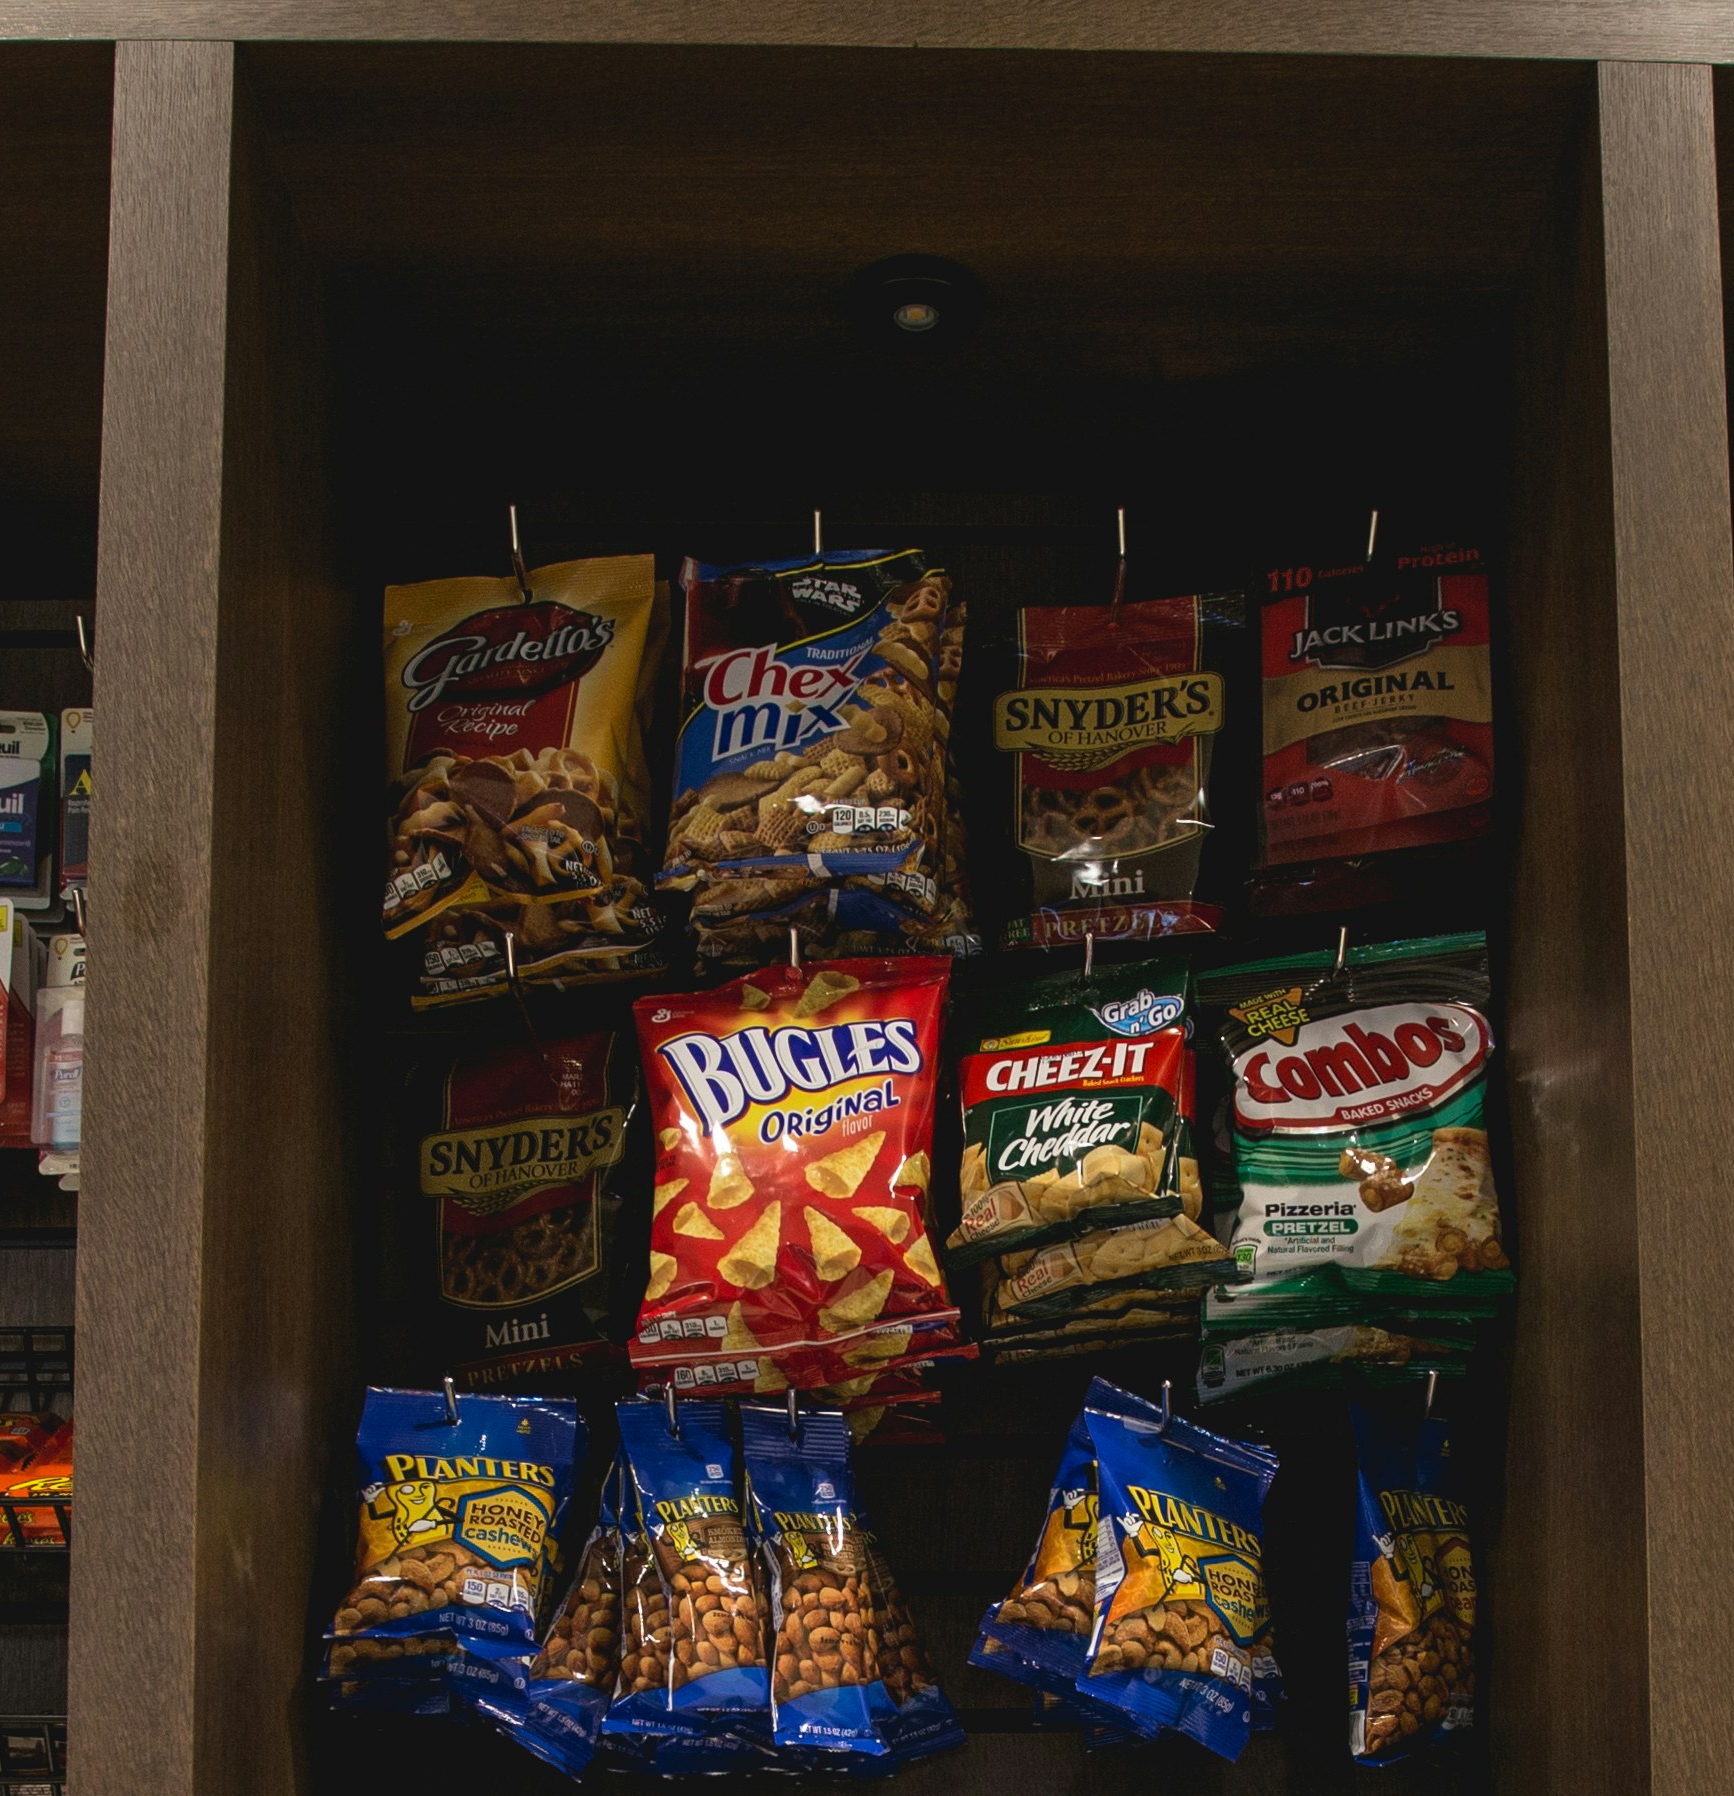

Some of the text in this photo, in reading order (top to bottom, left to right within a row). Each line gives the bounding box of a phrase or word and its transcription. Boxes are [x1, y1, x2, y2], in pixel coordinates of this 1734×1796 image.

[1396, 547, 1480, 571] Protein
[1267, 567, 1313, 591] 110
[806, 637, 875, 661] TRADITIONAL
[1290, 609, 1460, 659] JACK LINK'S
[700, 645, 868, 708] Chex
[1296, 670, 1454, 713] ORIGINAL
[438, 698, 530, 726] Original
[1006, 680, 1213, 732] SNYDER'S
[445, 717, 519, 737] Recipe
[1048, 721, 1167, 744] OF HANOVER
[1069, 869, 1146, 900] Mini
[1103, 992, 1153, 1024] Grab
[1147, 1004, 1177, 1027] Go
[1247, 1000, 1296, 1023] REAL
[1247, 1009, 1311, 1038] CHEESE
[986, 1042, 1154, 1092] CHEEZ-IT
[1243, 1016, 1465, 1104] Combos
[659, 1019, 922, 1138] BUGLES
[1025, 1097, 1115, 1138] White
[1342, 1087, 1433, 1120] BAKED SNACKS
[842, 1114, 873, 1137] flavor
[430, 1117, 614, 1174] SNYDER'S
[998, 1120, 1132, 1172] Cheddar
[469, 1160, 579, 1188] OF HANOVER
[1264, 1202, 1354, 1218] Pizzeria
[1271, 1220, 1350, 1235] PRETZEL
[484, 1311, 552, 1350] Mini
[467, 1352, 582, 1387] PRETZELS
[385, 1454, 555, 1487] PLANTERS
[471, 1503, 545, 1532] HONEY
[656, 1497, 739, 1523] PLANTERS
[1126, 1485, 1262, 1559] PLANTERS
[469, 1516, 541, 1544] ROASTED
